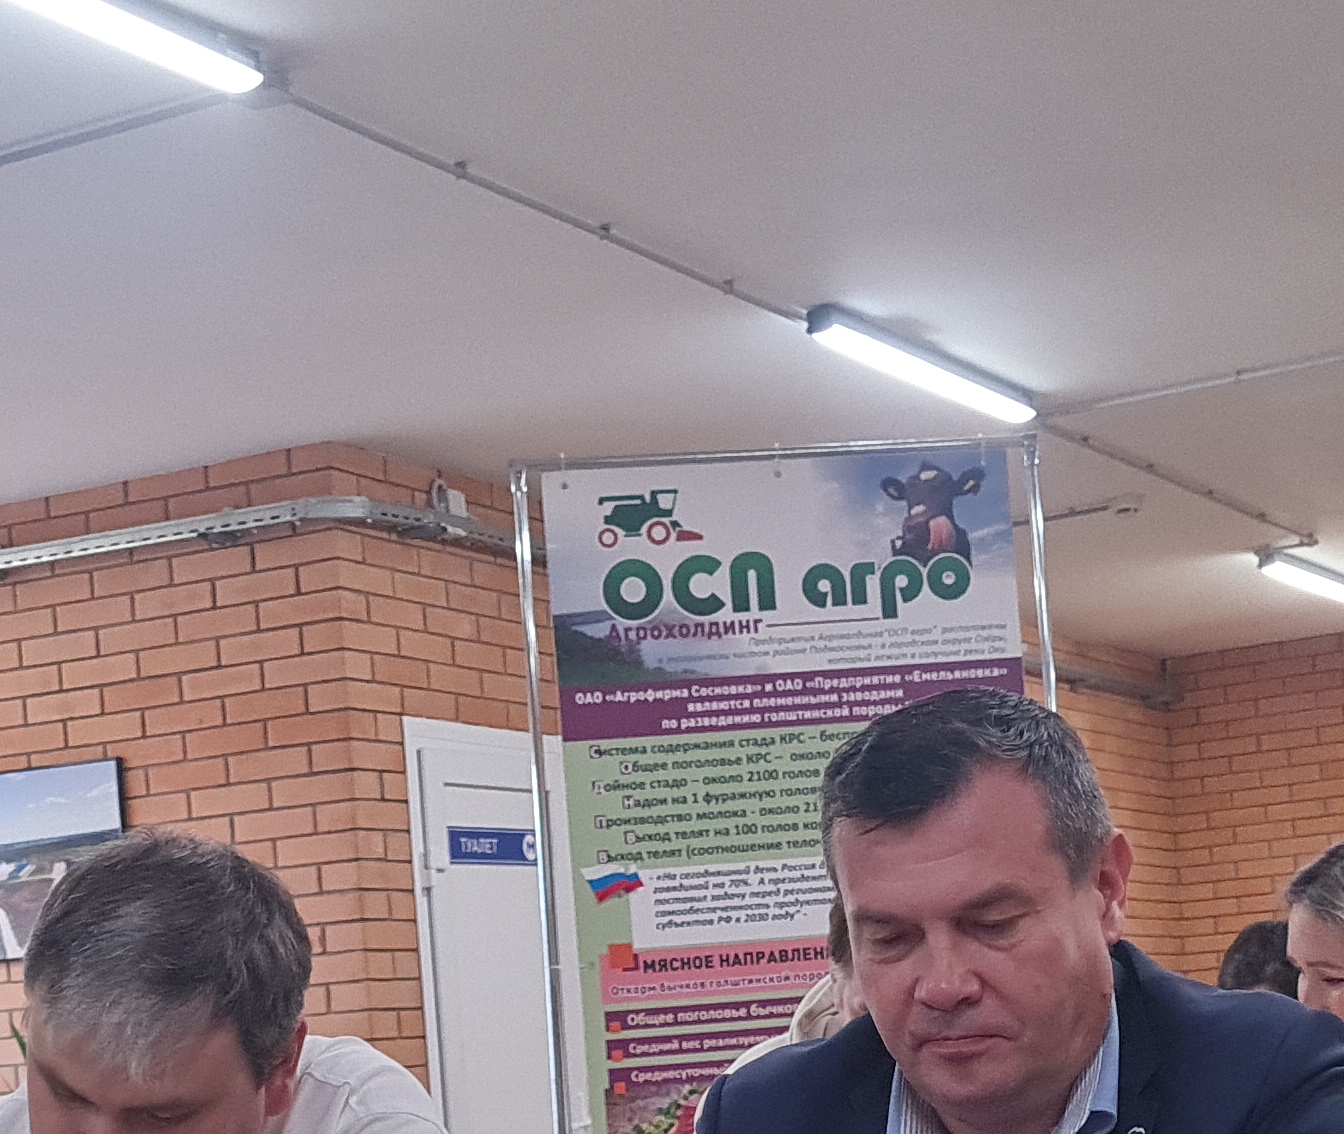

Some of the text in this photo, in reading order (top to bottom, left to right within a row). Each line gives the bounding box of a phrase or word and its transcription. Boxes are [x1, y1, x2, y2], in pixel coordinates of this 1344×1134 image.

[603, 551, 971, 621] ОСП агро
[606, 618, 764, 645] Агрохолдинг
[738, 736, 776, 748] стада
[778, 731, 806, 745] КРС
[745, 751, 773, 765] КРС
[790, 750, 831, 762] около
[649, 768, 820, 790] стадо около 2100 голов
[690, 792, 699, 804] 1
[696, 805, 800, 821] молока около
[734, 822, 758, 836] 100
[761, 821, 799, 834] голов
[642, 953, 715, 974] МЯСНОЕ
